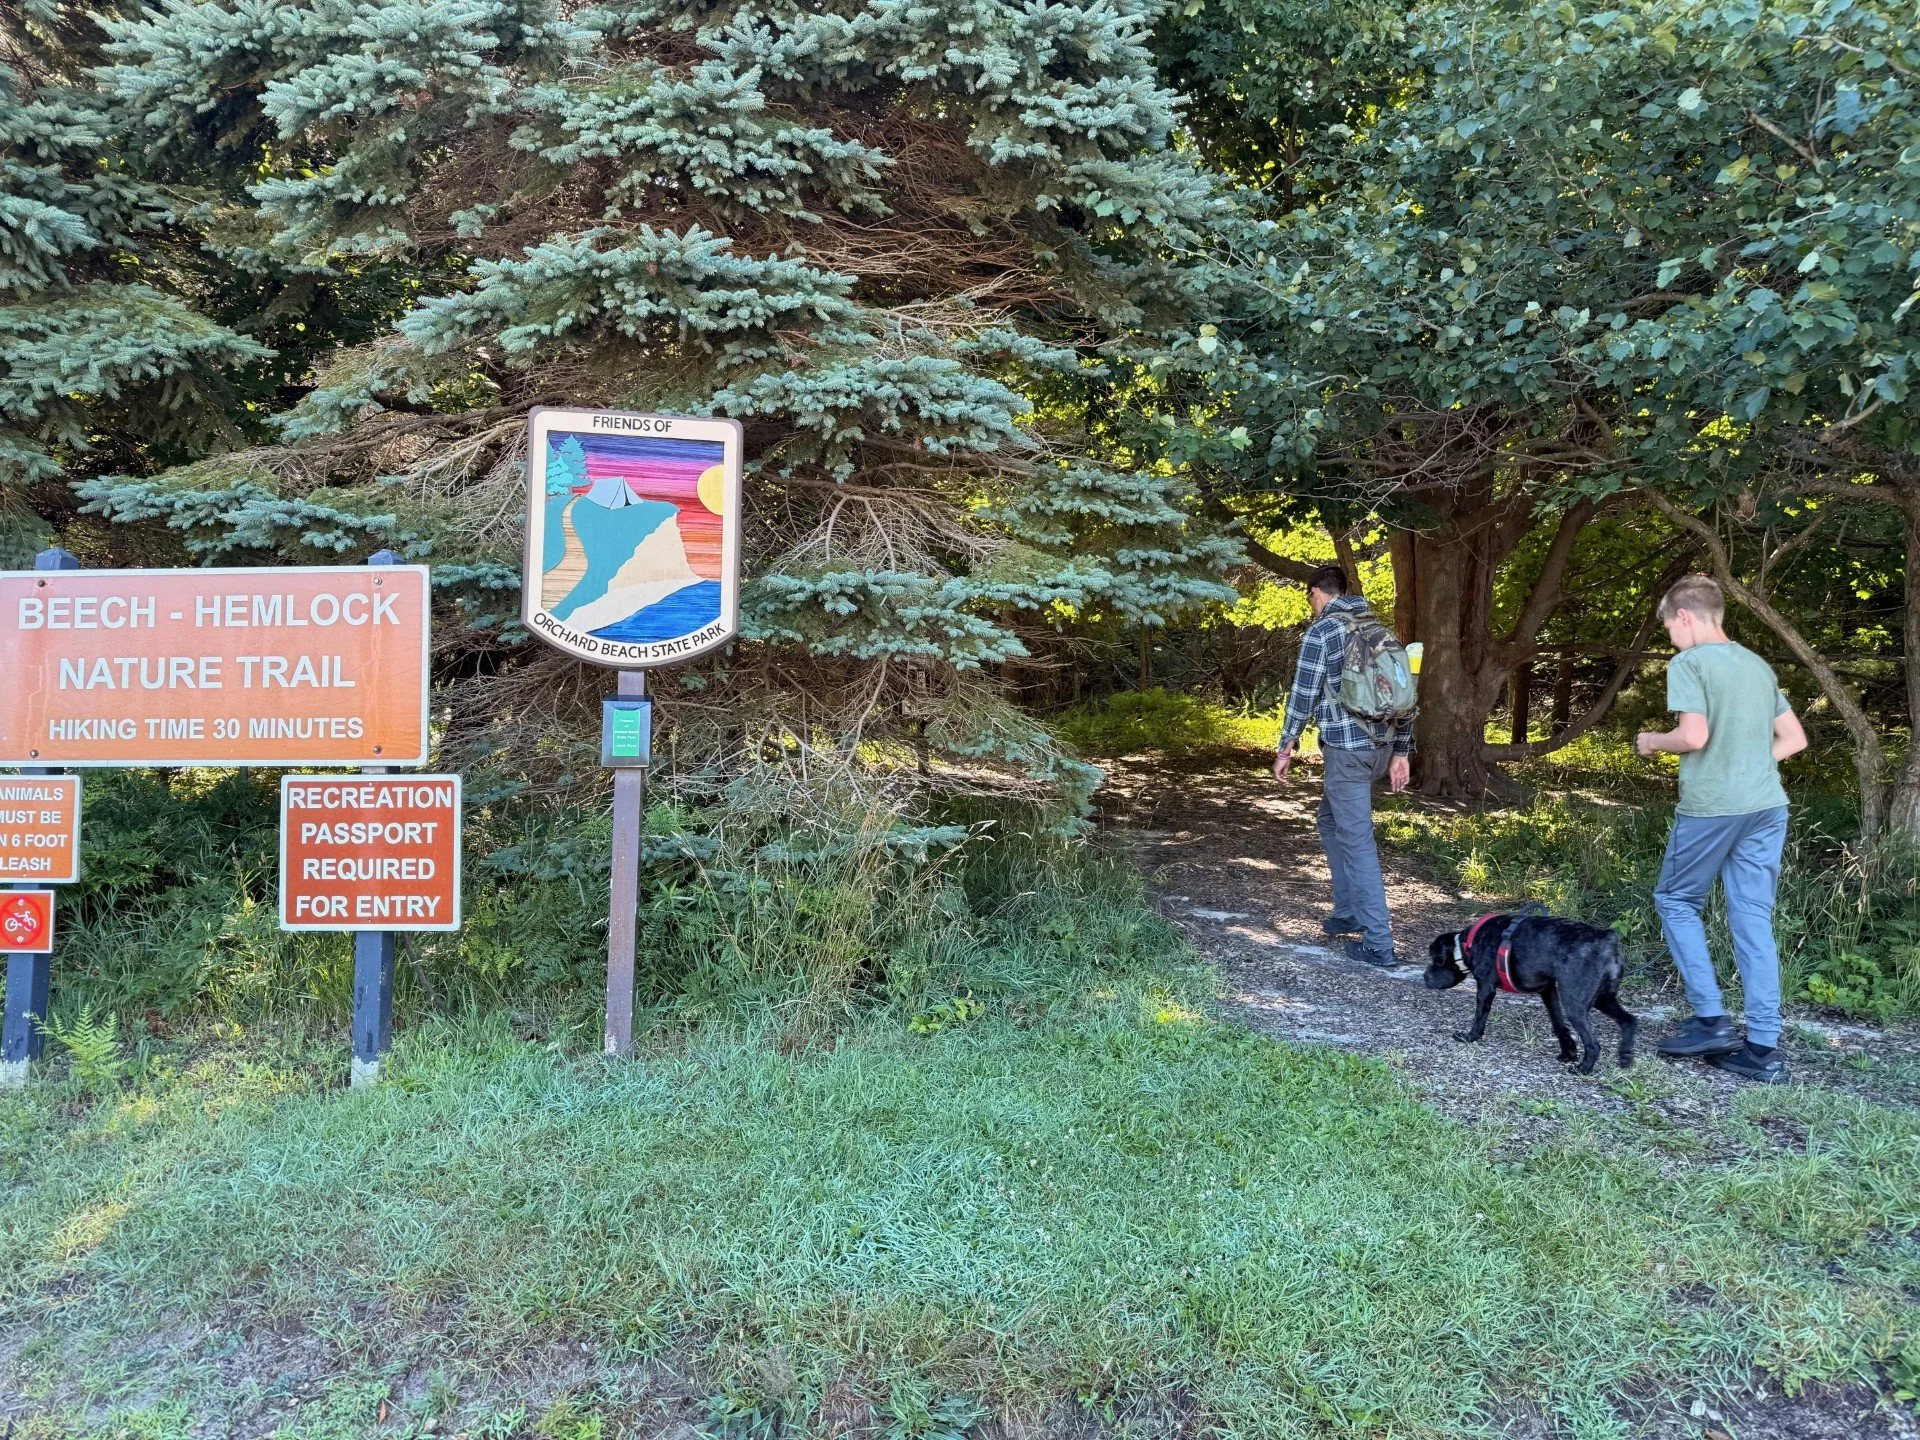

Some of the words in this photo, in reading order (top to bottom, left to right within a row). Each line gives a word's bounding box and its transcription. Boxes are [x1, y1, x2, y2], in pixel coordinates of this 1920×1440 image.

[593, 416, 651, 432] FRIENDS
[654, 420, 673, 433] OF
[18, 596, 156, 630] BEECH
[170, 611, 182, 619] -
[195, 592, 401, 628] HEMLOCK
[533, 612, 598, 653] ORCHARD
[600, 643, 649, 659] BEACH
[651, 638, 692, 658] STATE
[692, 622, 727, 647] PARK
[59, 656, 223, 690] NATURE
[235, 655, 356, 688] TRAIL
[48, 718, 136, 740] HIKING
[144, 718, 204, 740] TIME
[212, 718, 241, 739] 30
[248, 717, 364, 740] MINUTES
[288, 786, 452, 809] RECREATION
[40, 811, 62, 824] BE
[11, 834, 20, 847] 6
[24, 834, 68, 848] FOOT
[301, 822, 438, 844] PASSPORT
[0, 857, 51, 871] LEASH
[303, 858, 435, 881] REQUIRED
[296, 895, 348, 918] FOR
[356, 895, 441, 918] ENTRY
